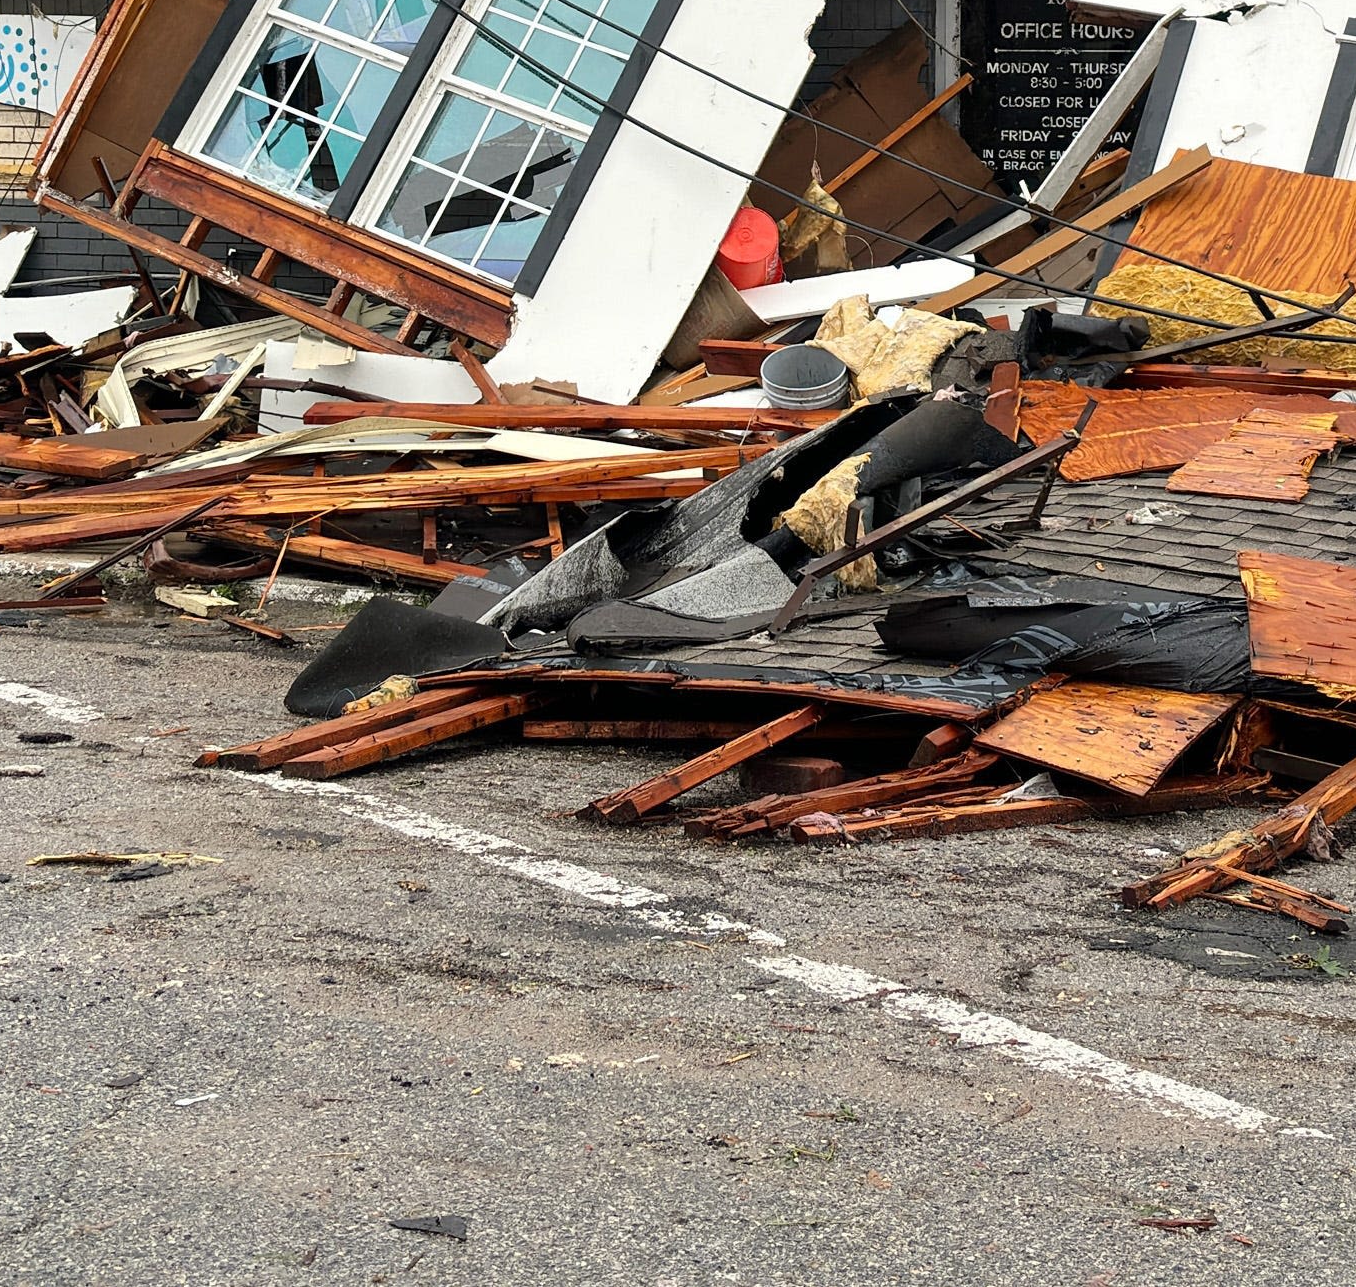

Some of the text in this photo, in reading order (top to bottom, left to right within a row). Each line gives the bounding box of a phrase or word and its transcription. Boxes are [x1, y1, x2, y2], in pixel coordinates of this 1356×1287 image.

[1000, 22, 1135, 39] OFFICE HOURS
[986, 62, 1050, 74] MONDAY
[1070, 62, 1129, 75] THURSD
[1030, 76, 1058, 89] 8:30
[1075, 77, 1103, 89] 5:00
[999, 96, 1051, 108] CLOSED
[1056, 97, 1083, 109] FOR
[1000, 130, 1051, 142] FRIDAY
[983, 149, 994, 159] IN
[998, 149, 1026, 159] CASE
[1030, 149, 1046, 160] OF
[1003, 160, 1044, 171] BRAGG
